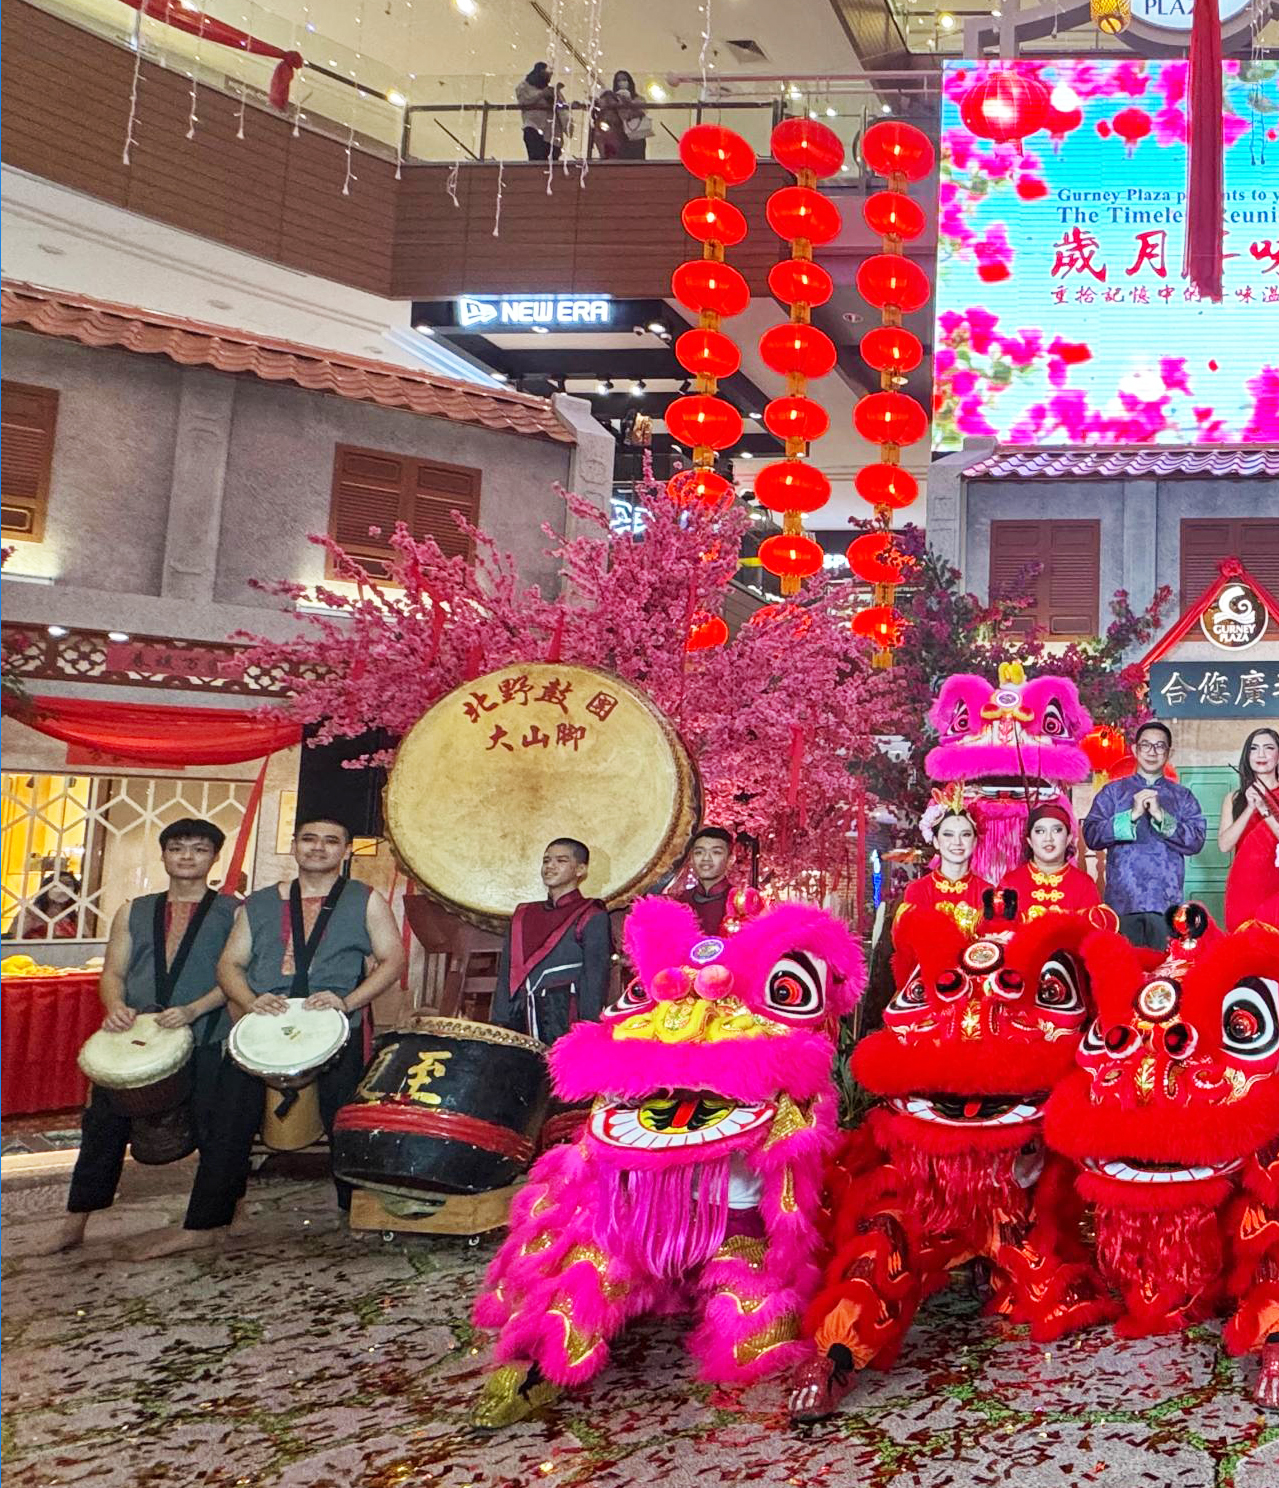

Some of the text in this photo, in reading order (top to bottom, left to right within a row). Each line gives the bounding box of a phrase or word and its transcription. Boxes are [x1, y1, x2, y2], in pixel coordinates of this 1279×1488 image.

[1145, 0, 1195, 15] PLA
[1057, 188, 1122, 204] Gurney
[1127, 188, 1171, 201] Plaza
[1177, 190, 1245, 204] pnts
[1252, 190, 1266, 201] to
[1057, 206, 1099, 223] The
[1107, 206, 1184, 223] Timele
[502, 300, 609, 322] NEW ERA
[1213, 624, 1256, 634] GURNEY
[1220, 633, 1249, 642] PLAZA
